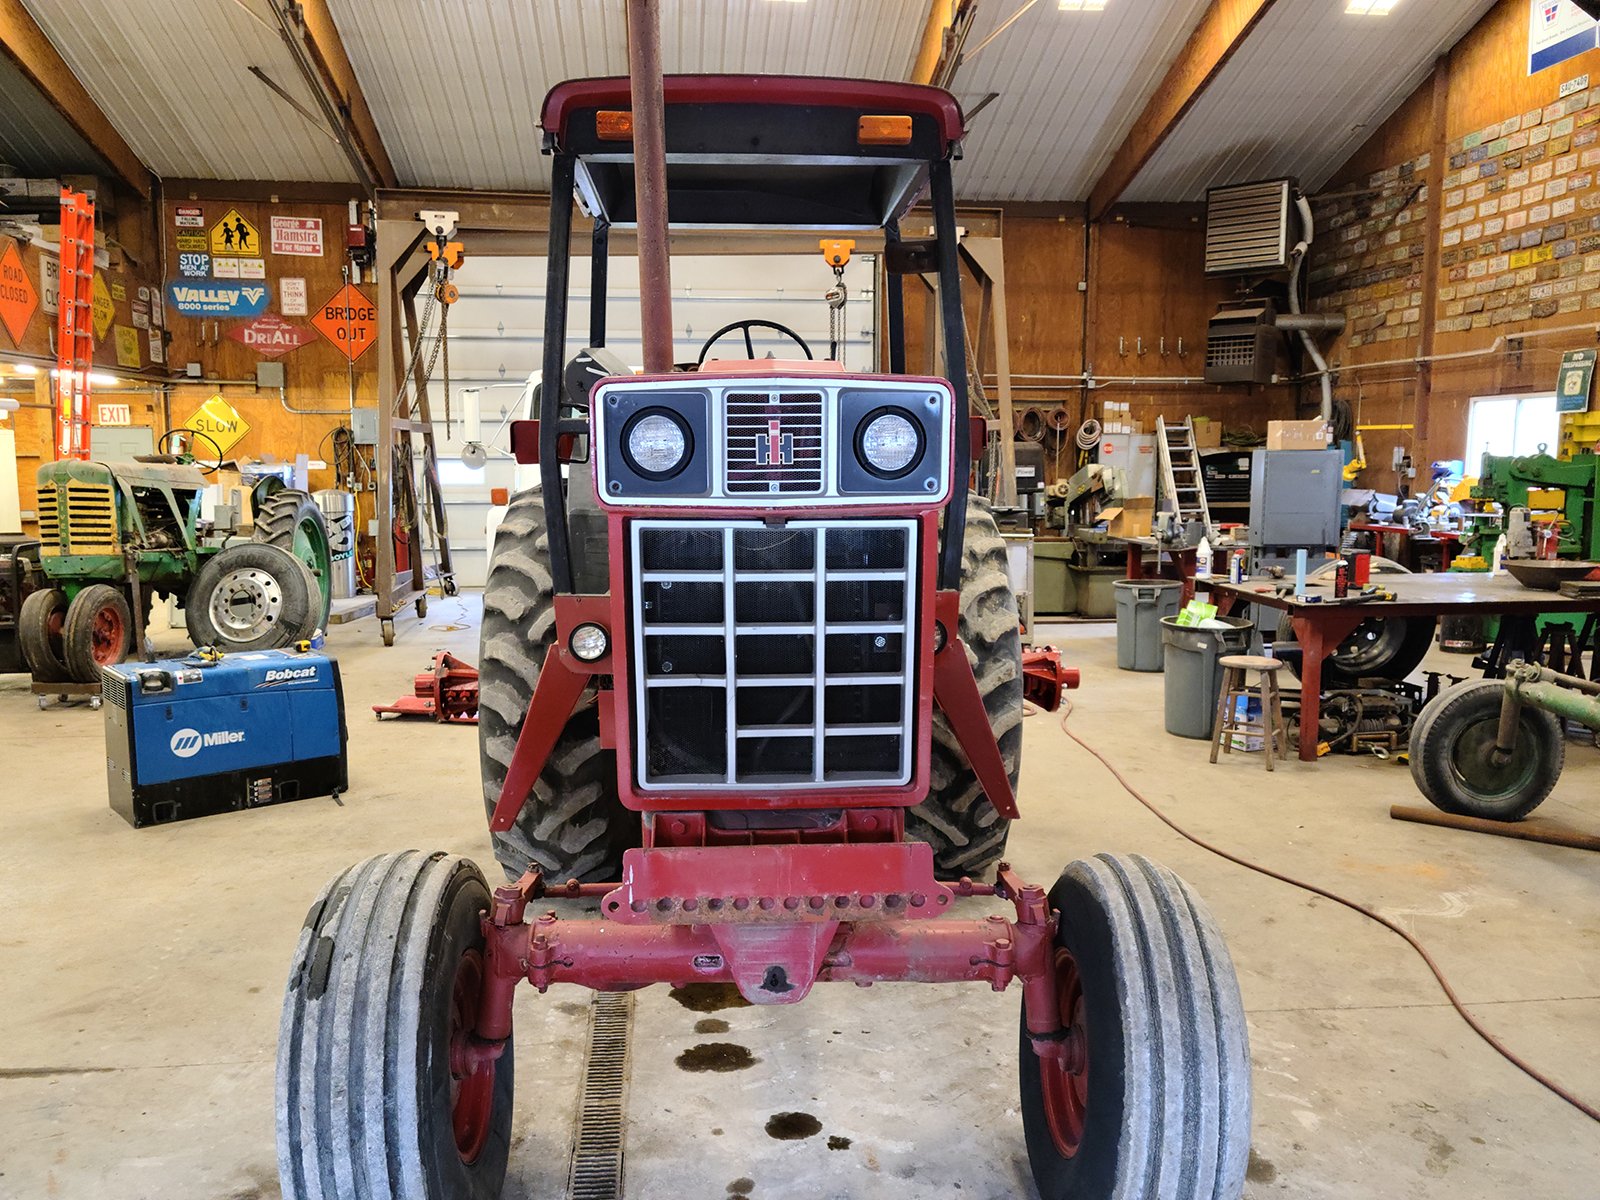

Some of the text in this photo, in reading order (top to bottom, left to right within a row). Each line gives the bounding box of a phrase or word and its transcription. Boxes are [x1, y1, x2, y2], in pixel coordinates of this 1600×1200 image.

[276, 229, 318, 242] Hamstra
[282, 243, 313, 253] For Mayor
[179, 253, 209, 265] STOP
[3, 264, 23, 283] ROAD
[0, 284, 28, 304] CLOSED
[203, 303, 230, 311] series
[336, 327, 366, 340] OUT
[1572, 352, 1584, 360] NO
[100, 406, 128, 423] EXIT
[196, 419, 238, 434] SLOW
[265, 665, 316, 682] Bobcat
[203, 730, 245, 747] Miller
